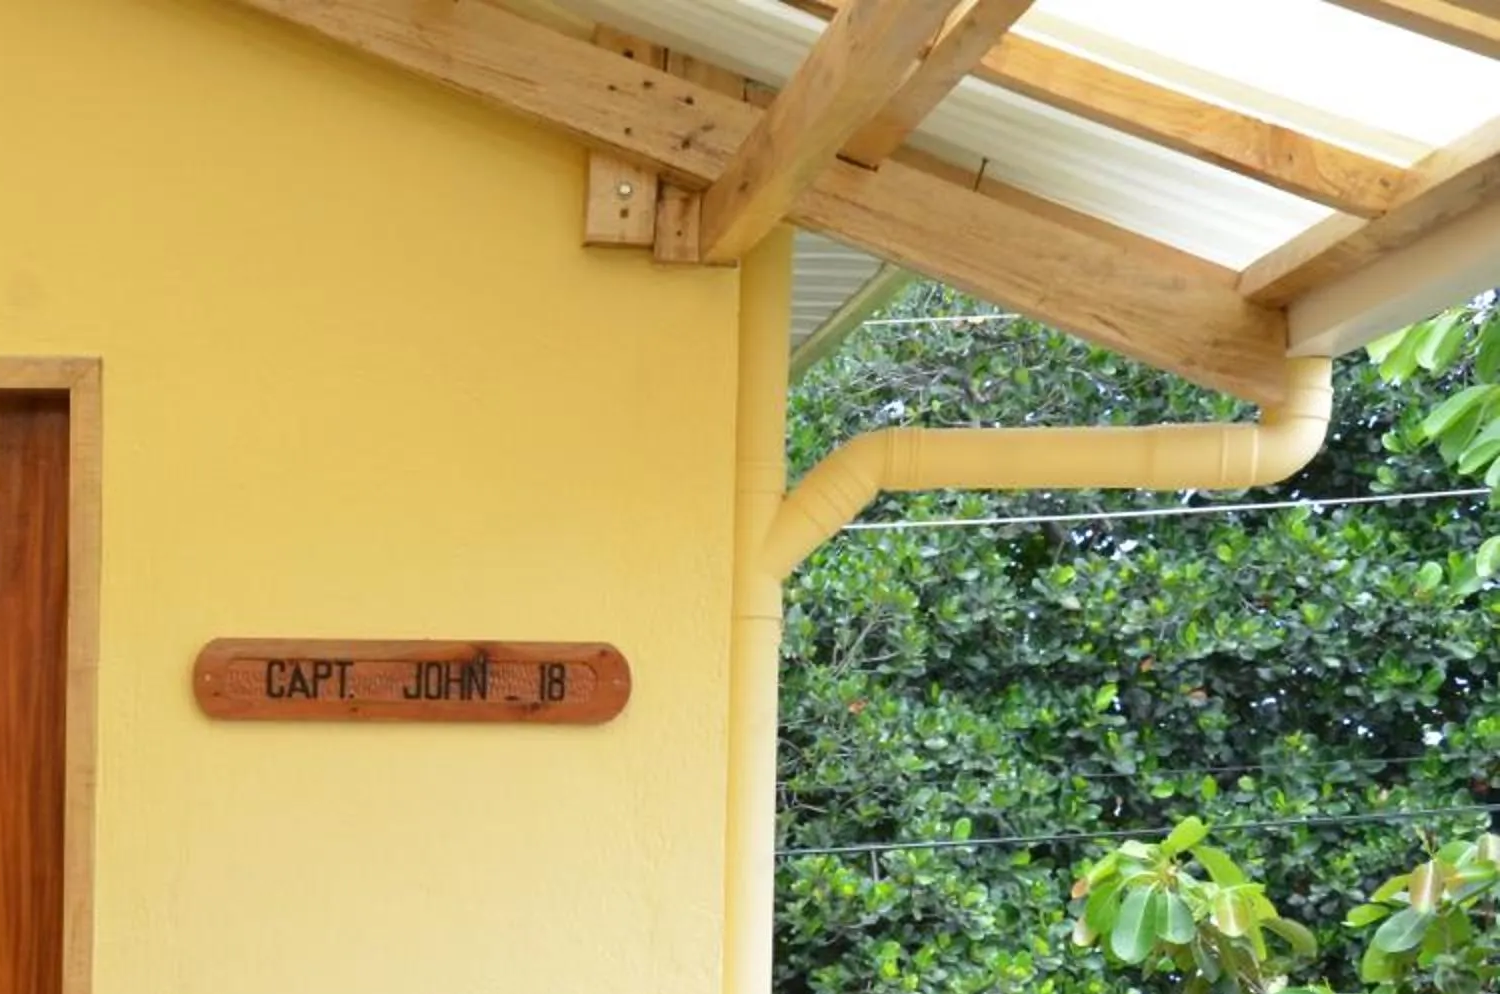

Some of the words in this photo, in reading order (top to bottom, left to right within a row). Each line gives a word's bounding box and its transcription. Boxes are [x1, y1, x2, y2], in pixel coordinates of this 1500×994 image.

[265, 660, 355, 700] CAPT.
[403, 660, 488, 701] JOHN
[539, 663, 566, 702] 18
